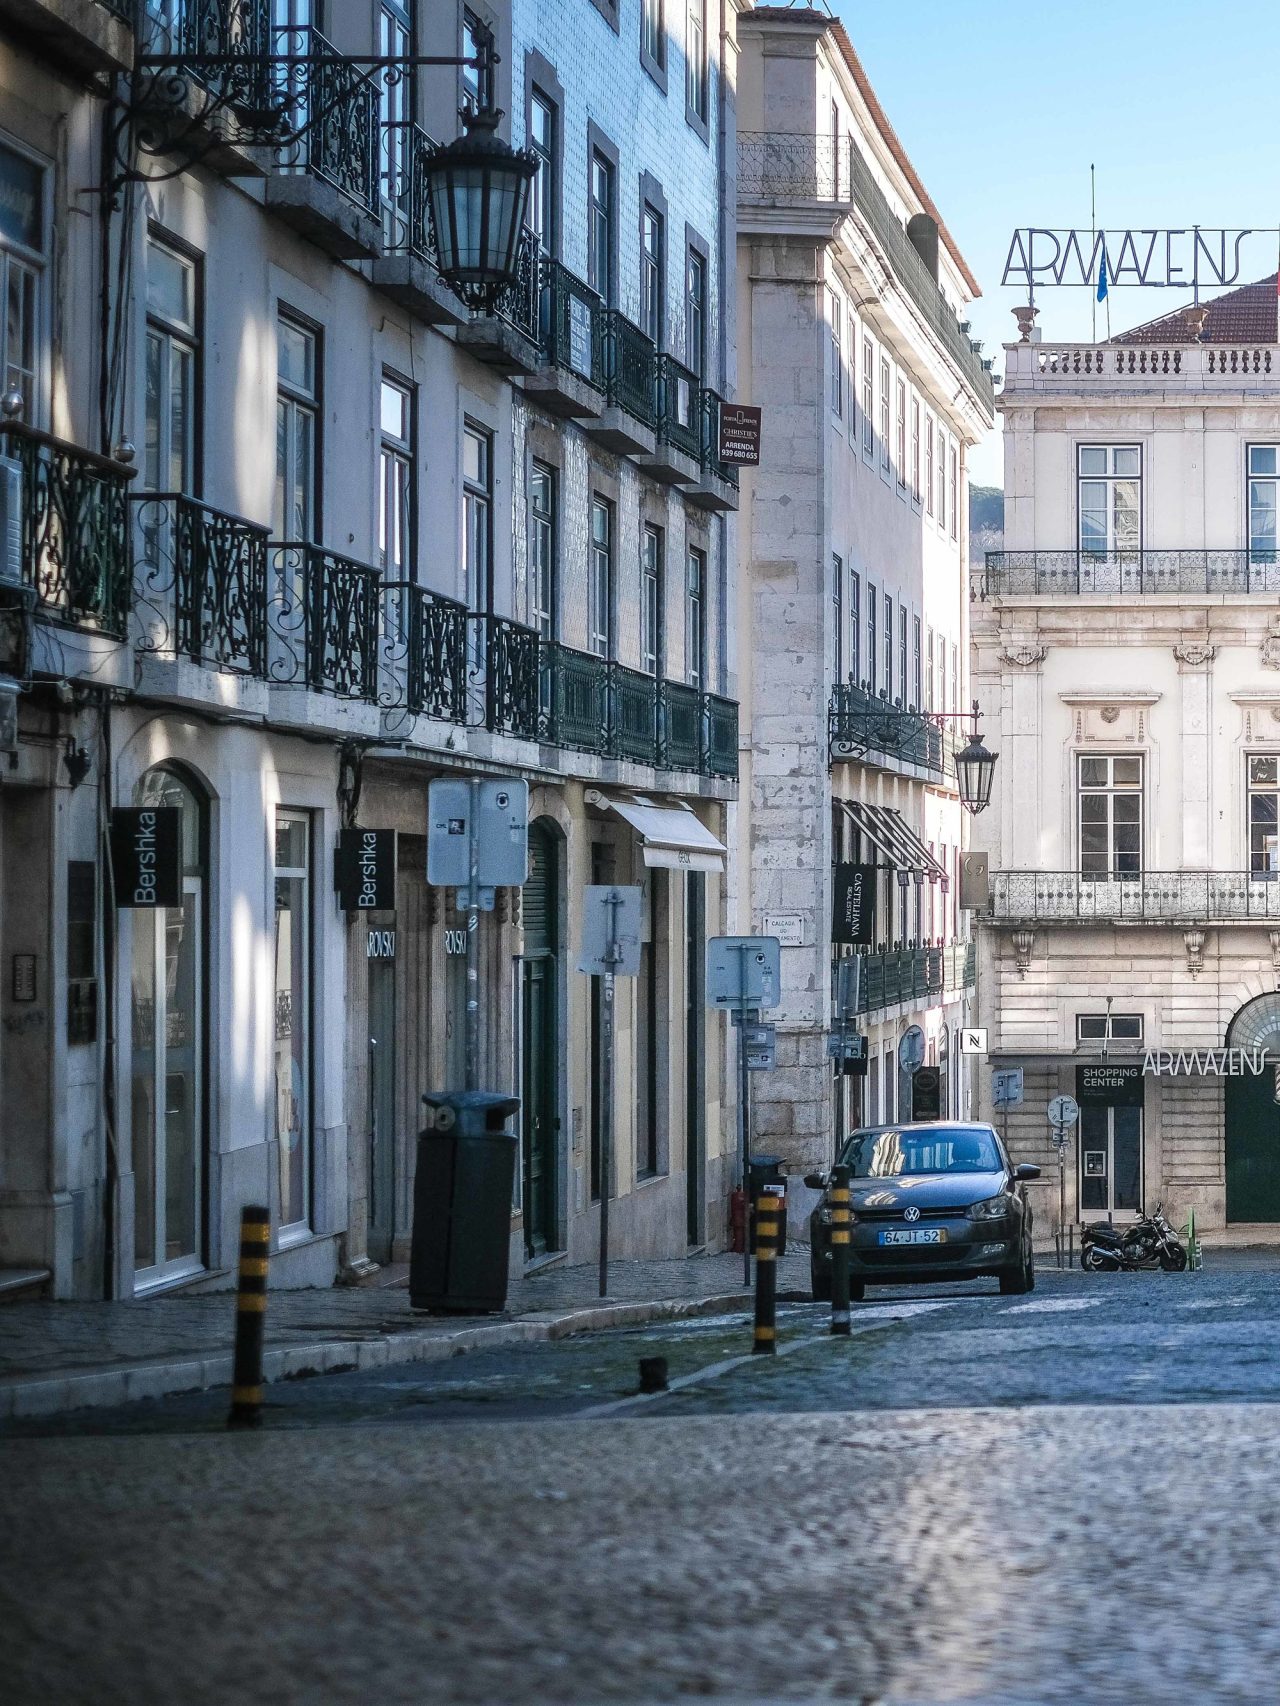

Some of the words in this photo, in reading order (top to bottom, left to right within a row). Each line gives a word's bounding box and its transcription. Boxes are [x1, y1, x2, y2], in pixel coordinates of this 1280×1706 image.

[1000, 228, 1252, 286] ARMAZENS
[721, 449, 733, 457] 939
[733, 450, 746, 458] 680
[746, 452, 758, 460] 655
[725, 442, 754, 450] ARRENDA
[134, 812, 156, 903] Bershka
[358, 832, 377, 907] Bershka
[851, 872, 863, 937] CASTELHANA
[1083, 1068, 1138, 1077] SHOPPING
[1141, 1047, 1269, 1076] ARMAZENS
[1083, 1078, 1124, 1087] CENTER
